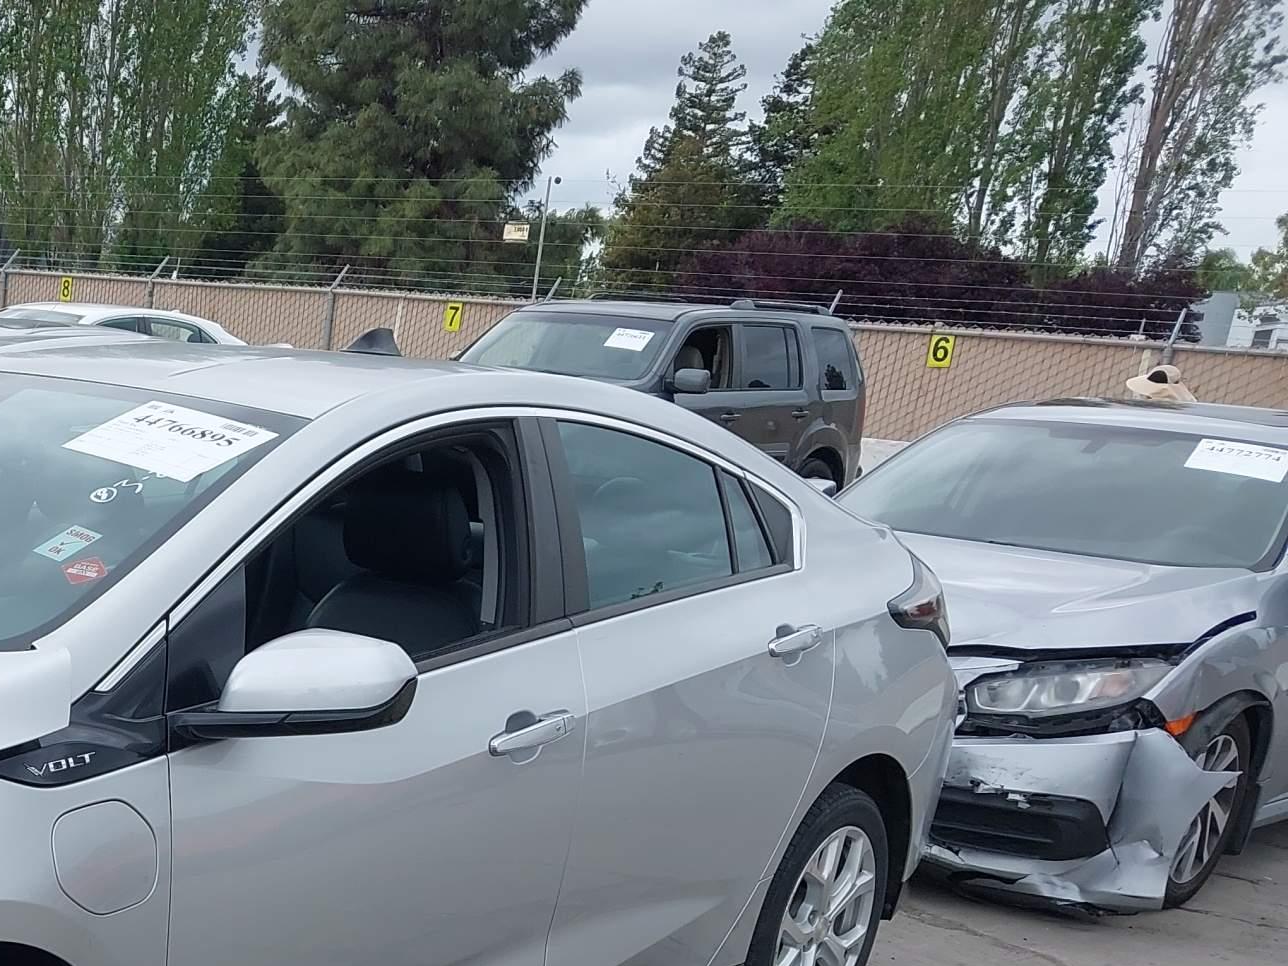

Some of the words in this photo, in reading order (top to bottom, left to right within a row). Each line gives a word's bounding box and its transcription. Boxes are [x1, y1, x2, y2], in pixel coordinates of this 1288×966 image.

[62, 279, 70, 298] 8
[448, 306, 460, 327] 7
[932, 336, 951, 363] 6
[133, 414, 241, 448] 44766895
[66, 529, 96, 543] SMOG
[48, 546, 66, 555] OK
[23, 751, 96, 777] VOLT
